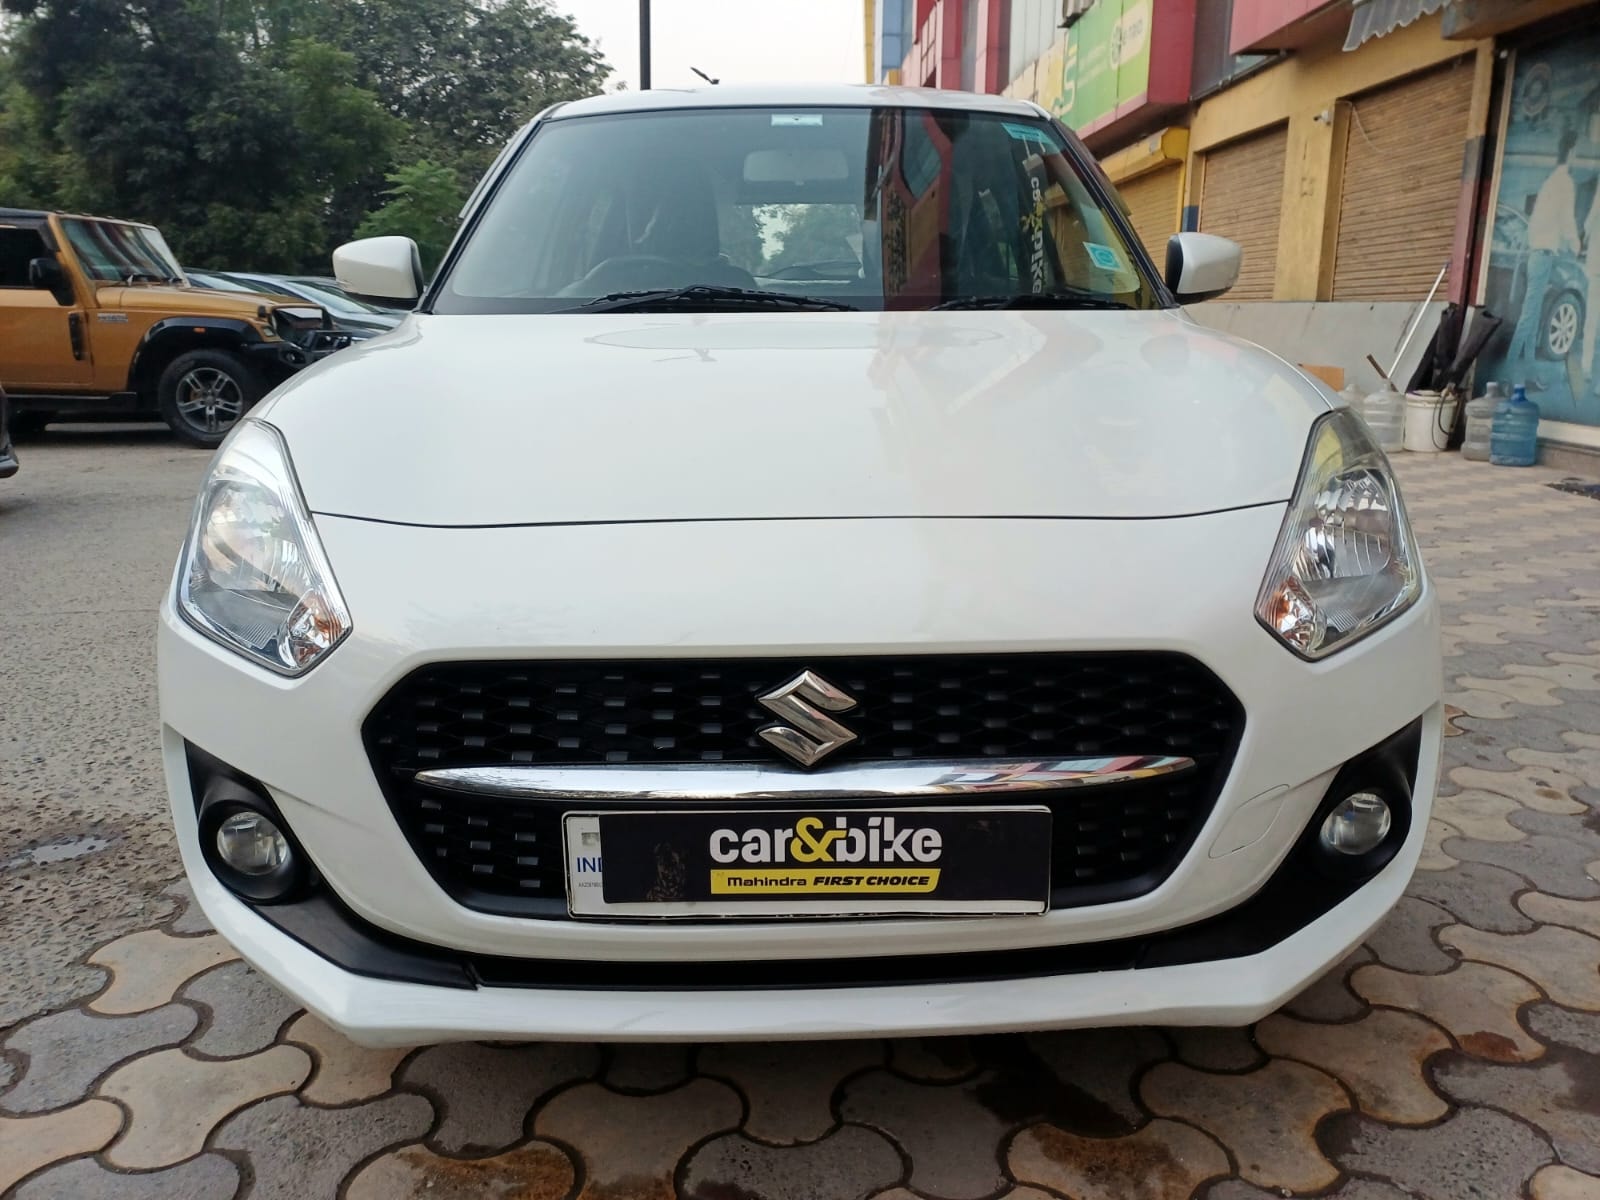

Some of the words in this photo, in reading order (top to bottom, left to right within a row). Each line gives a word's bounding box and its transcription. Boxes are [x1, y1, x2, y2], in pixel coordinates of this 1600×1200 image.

[709, 816, 943, 863] car&bike
[727, 876, 808, 887] Mahindra
[813, 876, 864, 886] FIRST
[866, 876, 930, 886] CHOICE
